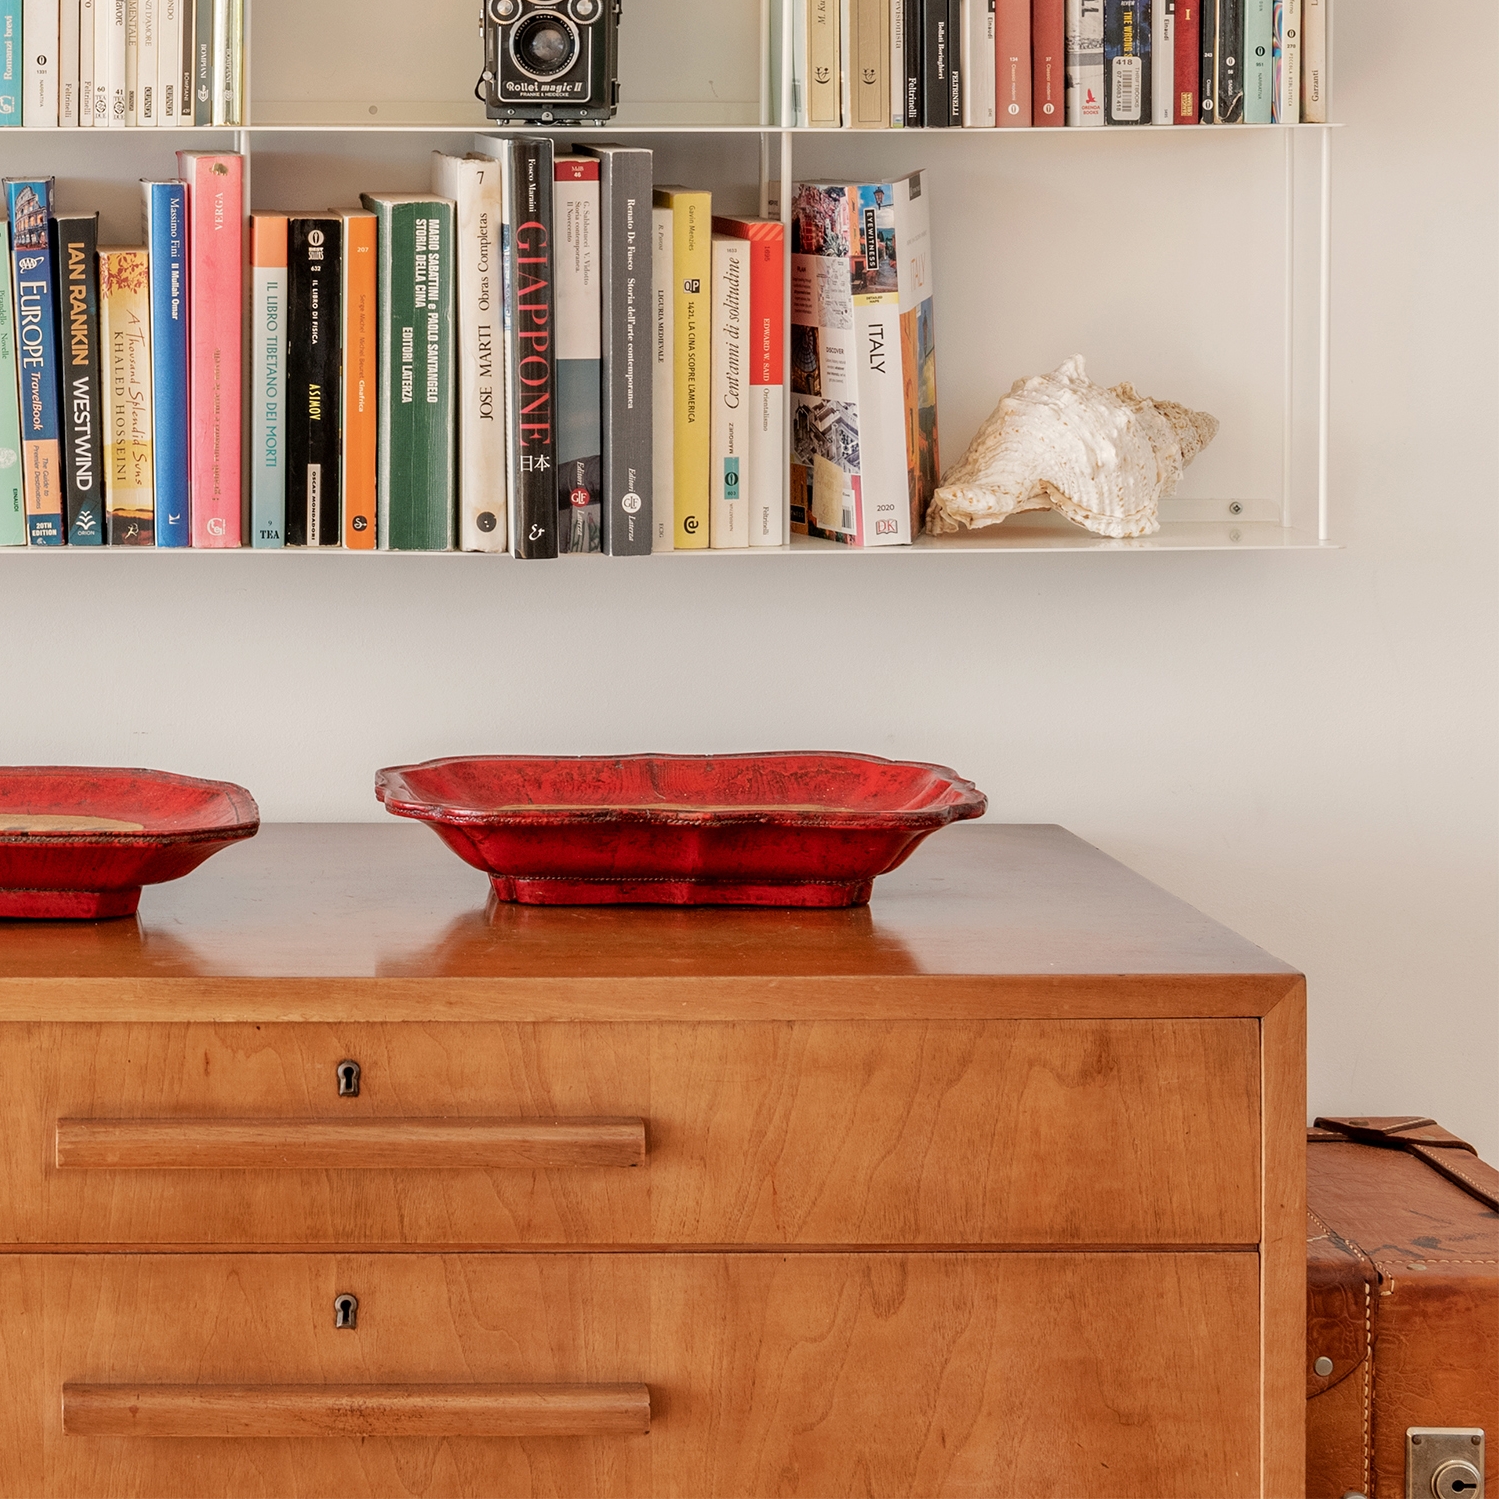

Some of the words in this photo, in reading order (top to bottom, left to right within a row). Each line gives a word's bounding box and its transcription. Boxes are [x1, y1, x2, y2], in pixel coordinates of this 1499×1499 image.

[3, 16, 12, 37] brevi
[3, 41, 12, 80] Romanzi
[506, 81, 539, 92] Rollei
[540, 83, 572, 93] magic
[573, 82, 583, 91] II
[908, 77, 917, 118] Feltrinelli
[528, 158, 536, 180] Fosco
[528, 182, 536, 212] Maraini
[415, 219, 426, 251] STORIA
[428, 219, 439, 250] MARIO
[867, 211, 876, 268] EYEWITNESS
[68, 243, 85, 282] IAN
[415, 254, 426, 281] DELLA
[428, 253, 439, 300] SABATTINI
[266, 280, 278, 292] IL
[415, 284, 426, 308] CINA
[19, 280, 47, 368] EUROPE
[69, 285, 88, 365] RANKIN
[265, 294, 278, 332] LIBRO
[427, 312, 439, 340] PAOLO
[687, 321, 695, 331] LA
[402, 327, 413, 362] EDITORI
[516, 221, 551, 447] GIAPPONE
[687, 332, 695, 351] CINA
[867, 323, 886, 374] ITALY
[265, 335, 278, 398] TIBETANO
[402, 365, 413, 403] LATERZA
[427, 343, 439, 403] SANTANGELO
[687, 352, 695, 382] SCOPRE
[29, 371, 43, 430] TravelBook
[265, 402, 278, 421] DEI
[308, 383, 321, 421] ASIMOV
[72, 376, 92, 490] WESTWIND
[265, 425, 278, 468] MORTI
[520, 455, 550, 472] 日本
[876, 504, 895, 512] 2020
